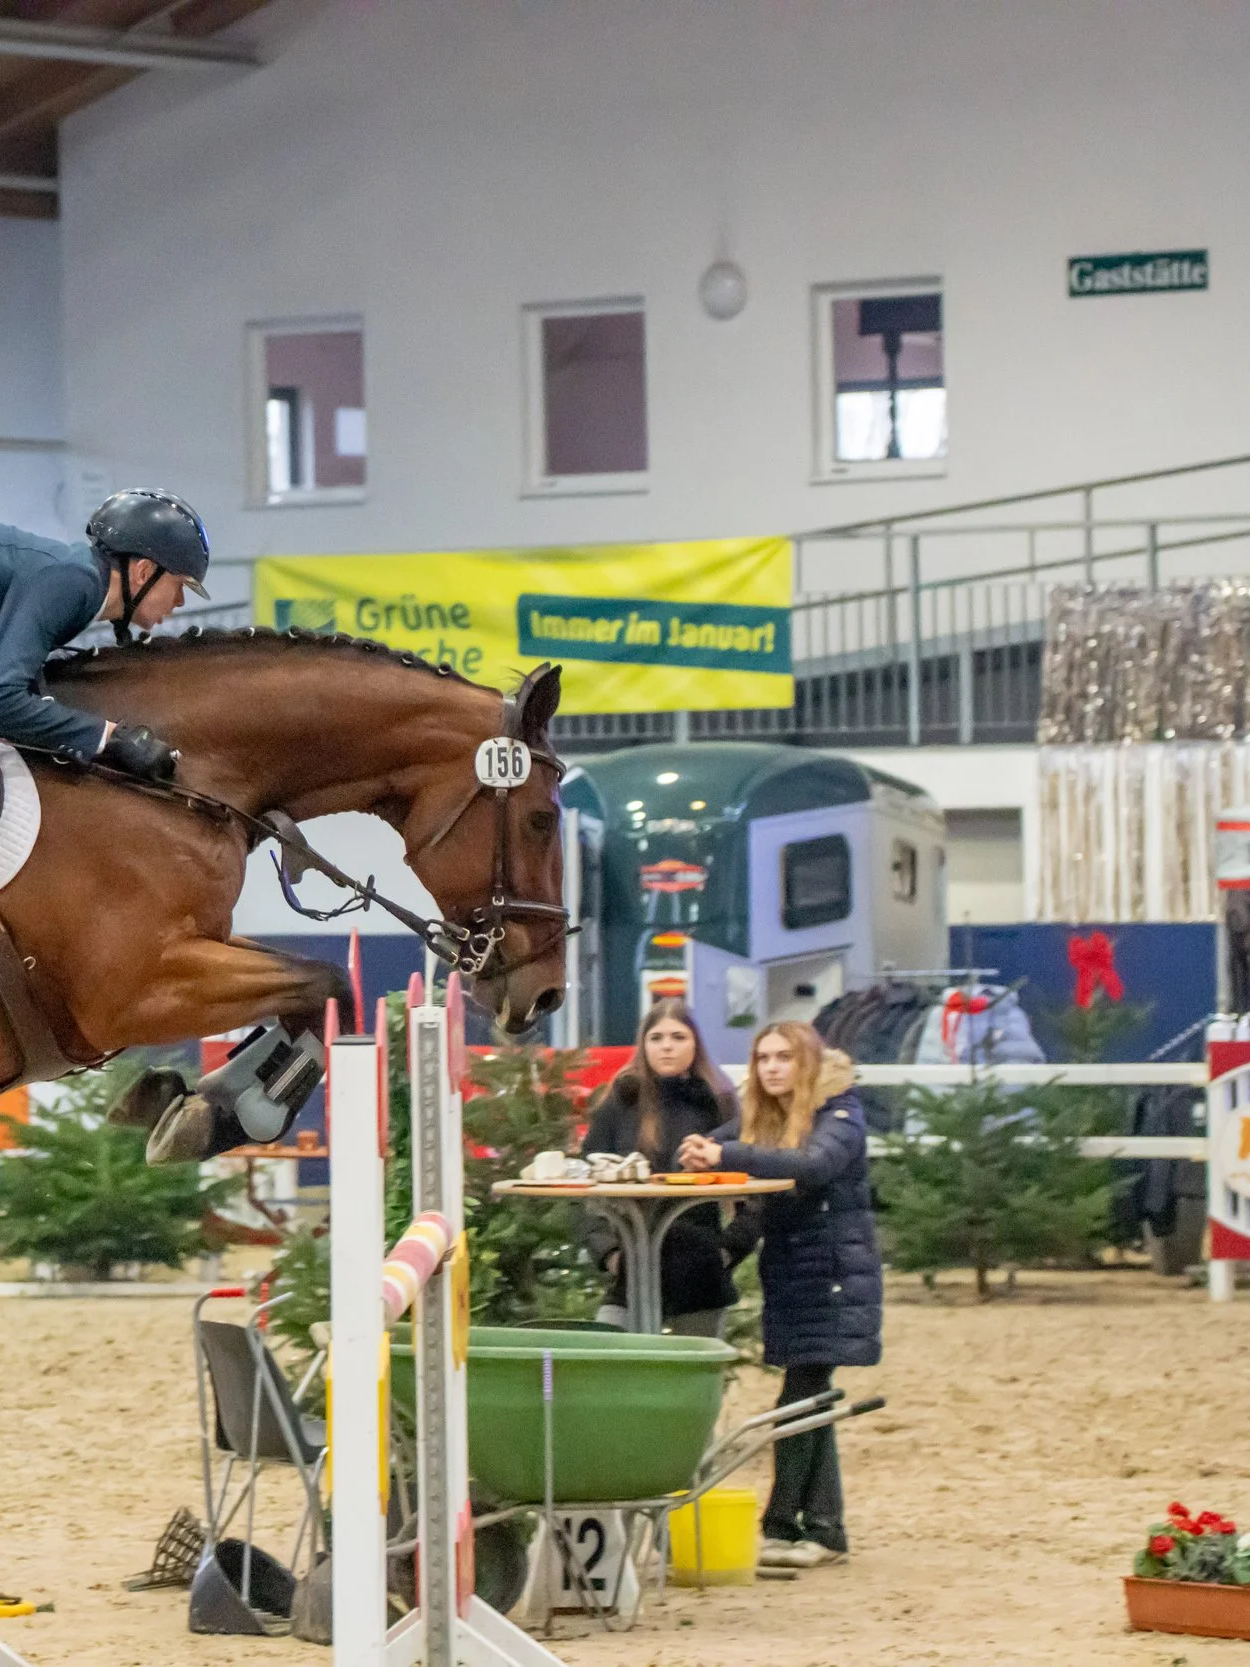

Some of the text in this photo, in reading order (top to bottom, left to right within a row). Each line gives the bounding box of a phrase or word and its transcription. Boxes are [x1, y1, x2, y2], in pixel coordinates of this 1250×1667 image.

[1070, 258, 1207, 292] Gaststätte
[355, 593, 472, 632] Grüne
[530, 610, 776, 653] Immer im Januar!
[485, 746, 524, 778] 156
